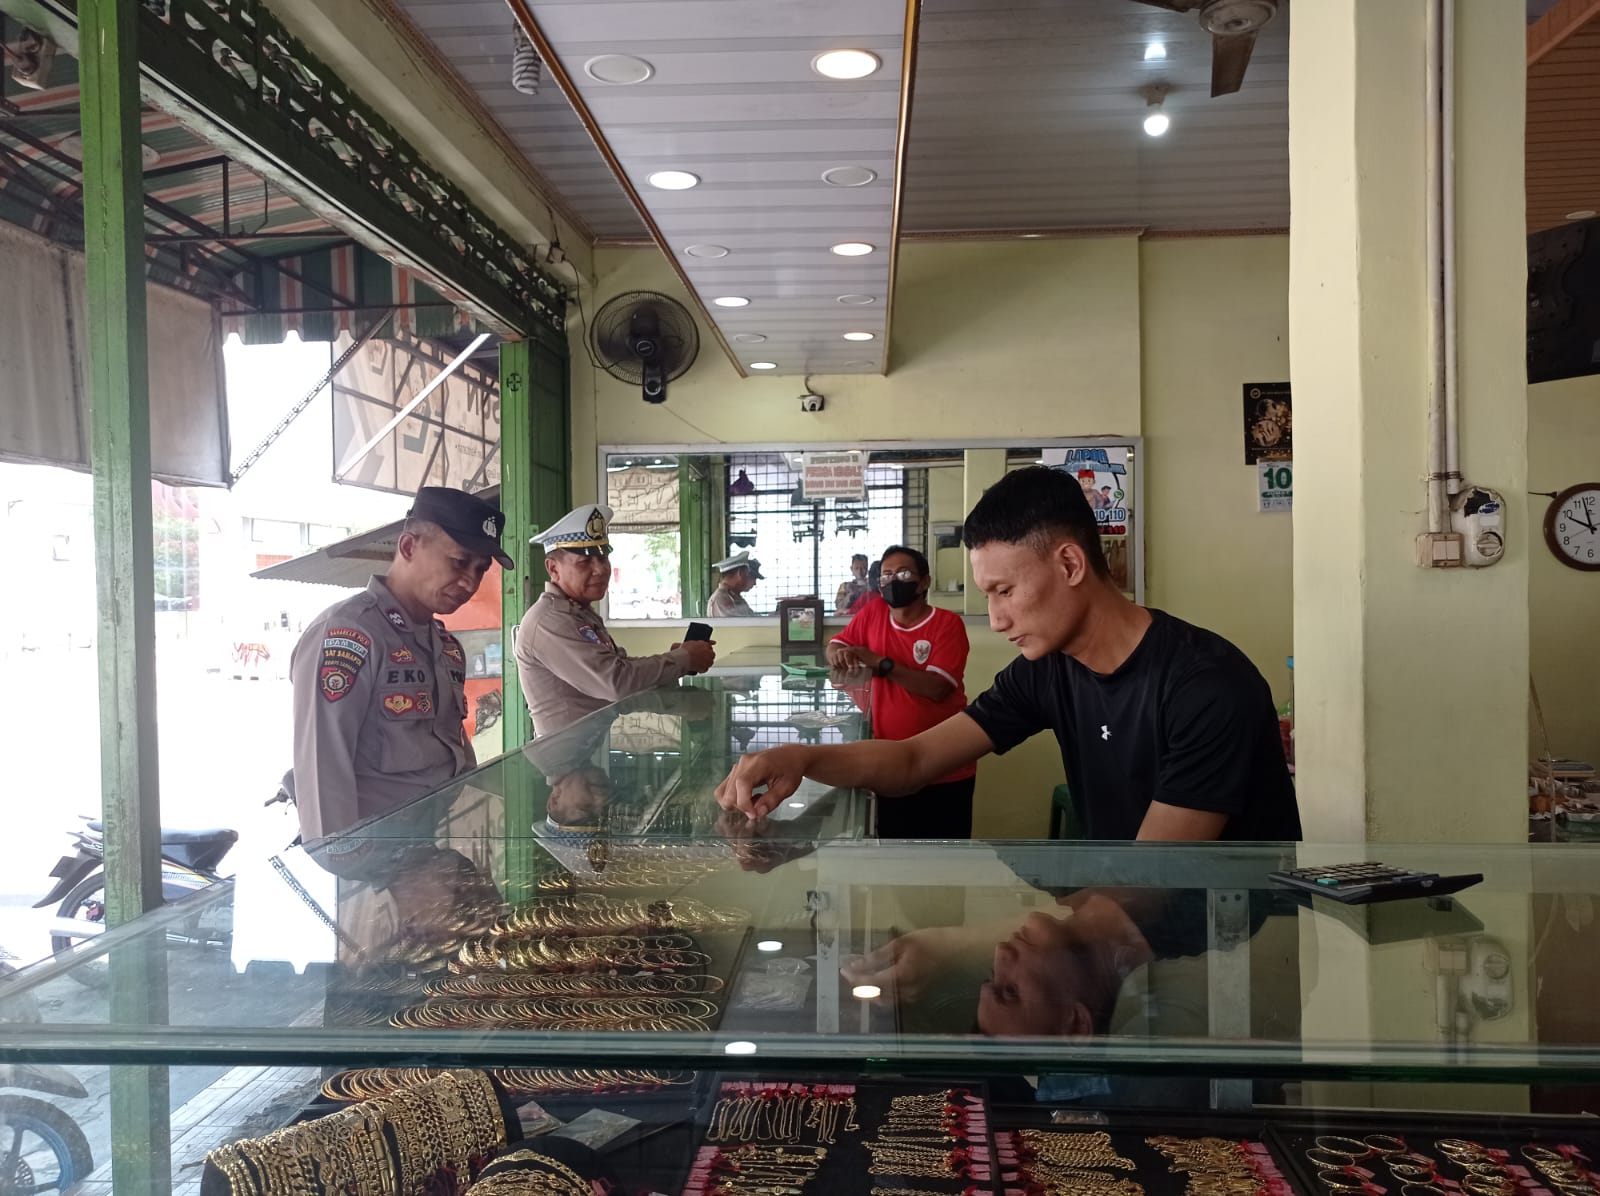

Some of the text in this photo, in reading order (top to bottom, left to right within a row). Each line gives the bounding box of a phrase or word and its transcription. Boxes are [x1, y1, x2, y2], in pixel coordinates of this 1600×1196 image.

[1264, 467, 1292, 489] 10
[1573, 500, 1581, 509] 11
[1585, 496, 1595, 506] 12
[1563, 509, 1573, 518] 10
[1559, 523, 1566, 532] 9
[1563, 536, 1570, 545] 8
[1574, 546, 1580, 555] 7
[1587, 549, 1594, 558] 6
[387, 669, 426, 684] EKO
